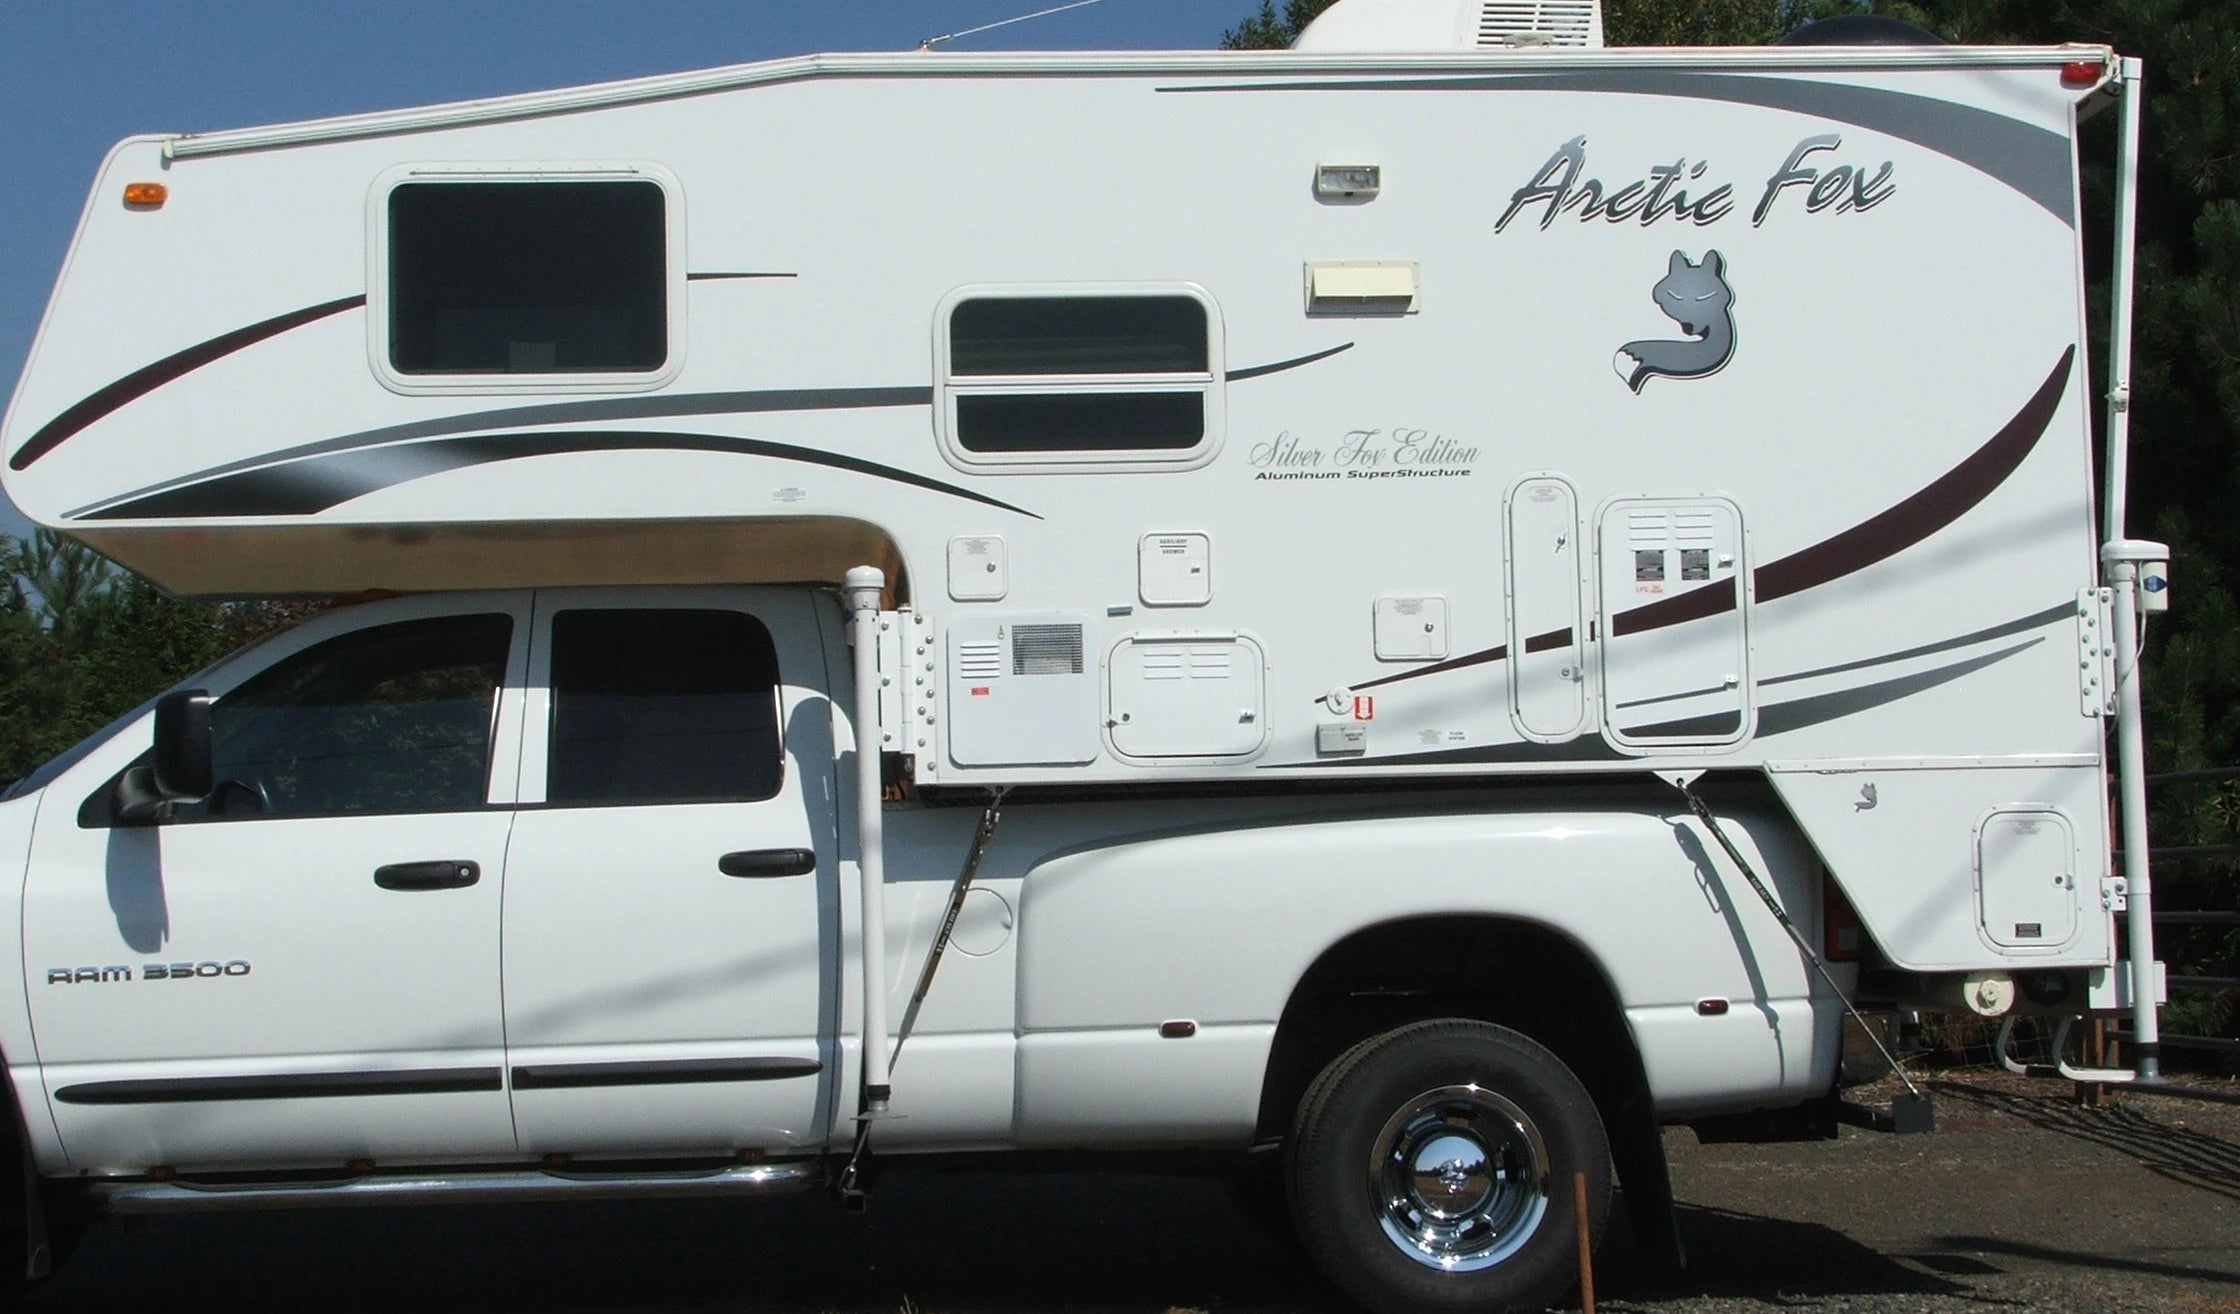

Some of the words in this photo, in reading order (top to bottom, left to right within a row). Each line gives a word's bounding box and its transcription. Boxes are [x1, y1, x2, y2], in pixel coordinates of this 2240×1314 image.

[1494, 134, 1734, 234] Arctic
[1753, 133, 1896, 228] Fox
[1249, 430, 1325, 468] Silver
[1333, 428, 1387, 469] Fox
[1392, 427, 1481, 467] Edition
[1255, 471, 1341, 481] Aluminum
[1347, 468, 1472, 480] SuperStructure
[48, 965, 132, 985] RAM
[143, 960, 251, 980] 3500
